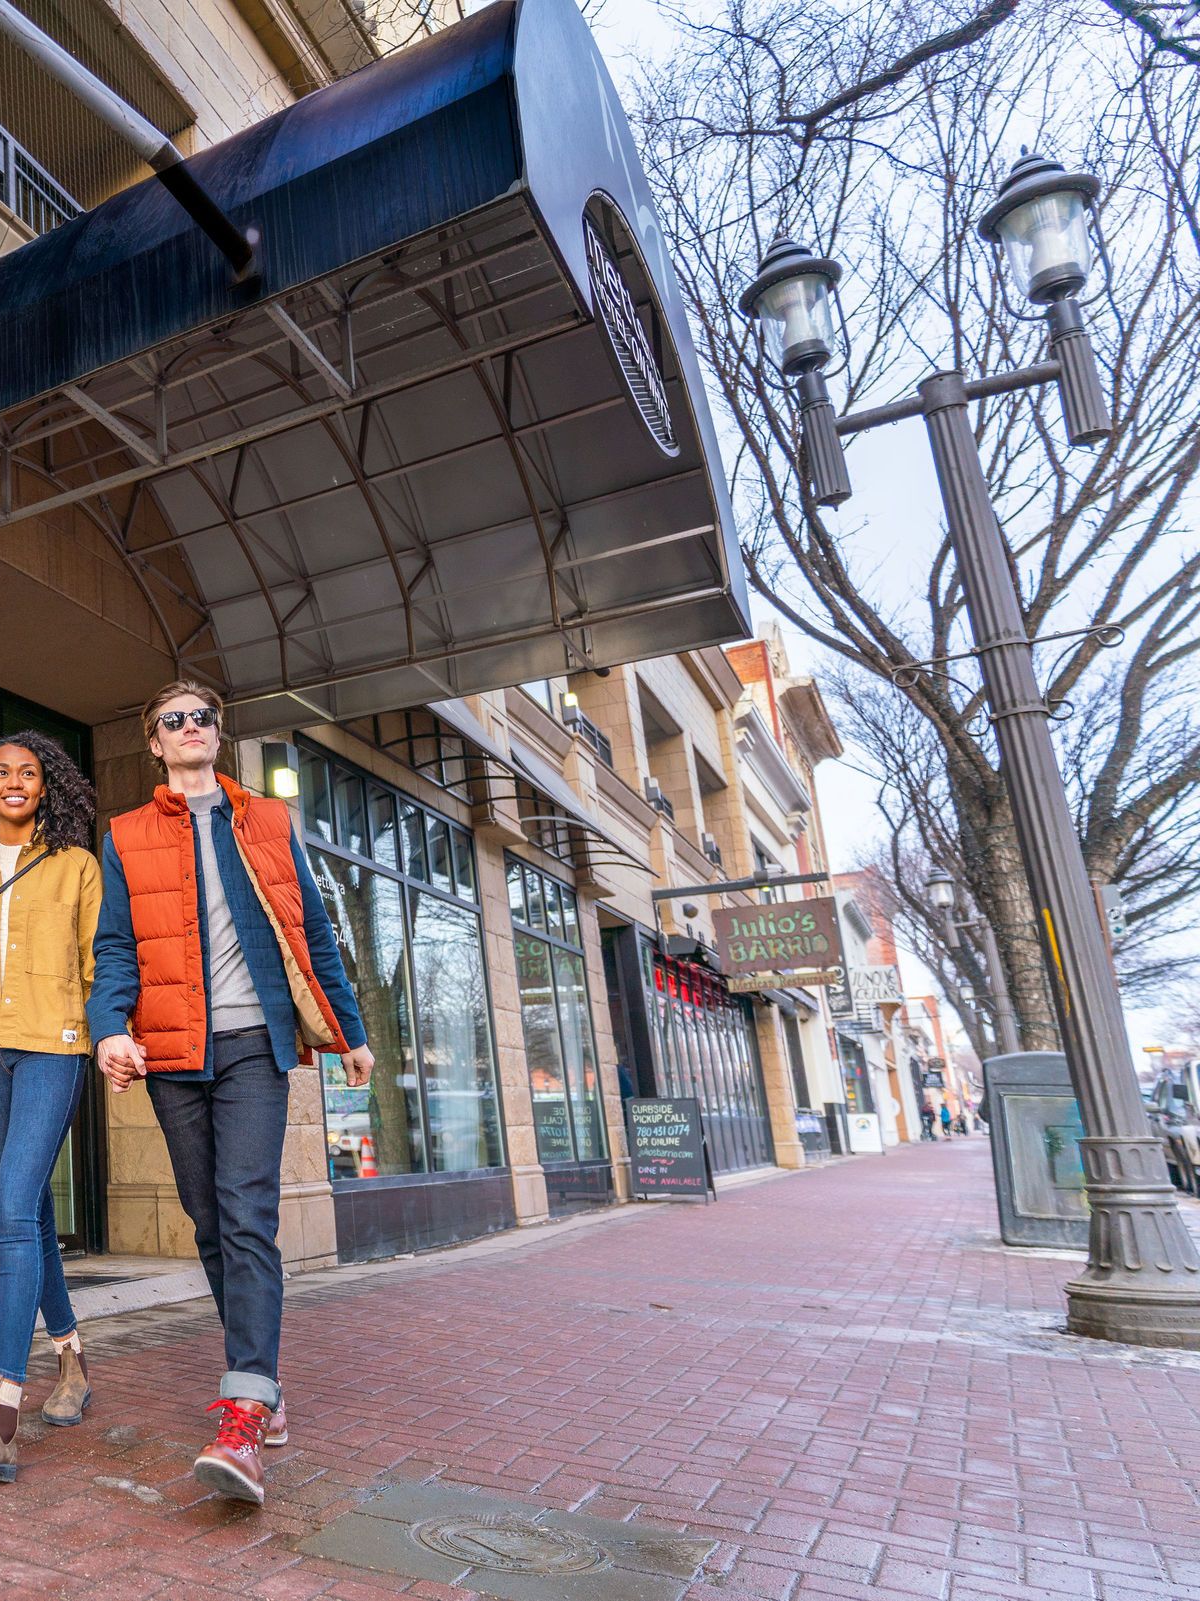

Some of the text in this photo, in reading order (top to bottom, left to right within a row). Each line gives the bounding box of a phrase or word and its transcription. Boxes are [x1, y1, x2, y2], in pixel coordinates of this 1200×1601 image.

[727, 910, 816, 940] Julio's
[728, 933, 829, 963] BARRIO
[632, 1105, 673, 1114] CURBSIDE
[633, 1114, 663, 1124] PICKUP
[636, 1126, 652, 1137] 780
[667, 1124, 690, 1137] 0774
[636, 1137, 680, 1147] OR ONLINE
[638, 1166, 657, 1175] DINE
[660, 1177, 701, 1186] AVAILABLE
